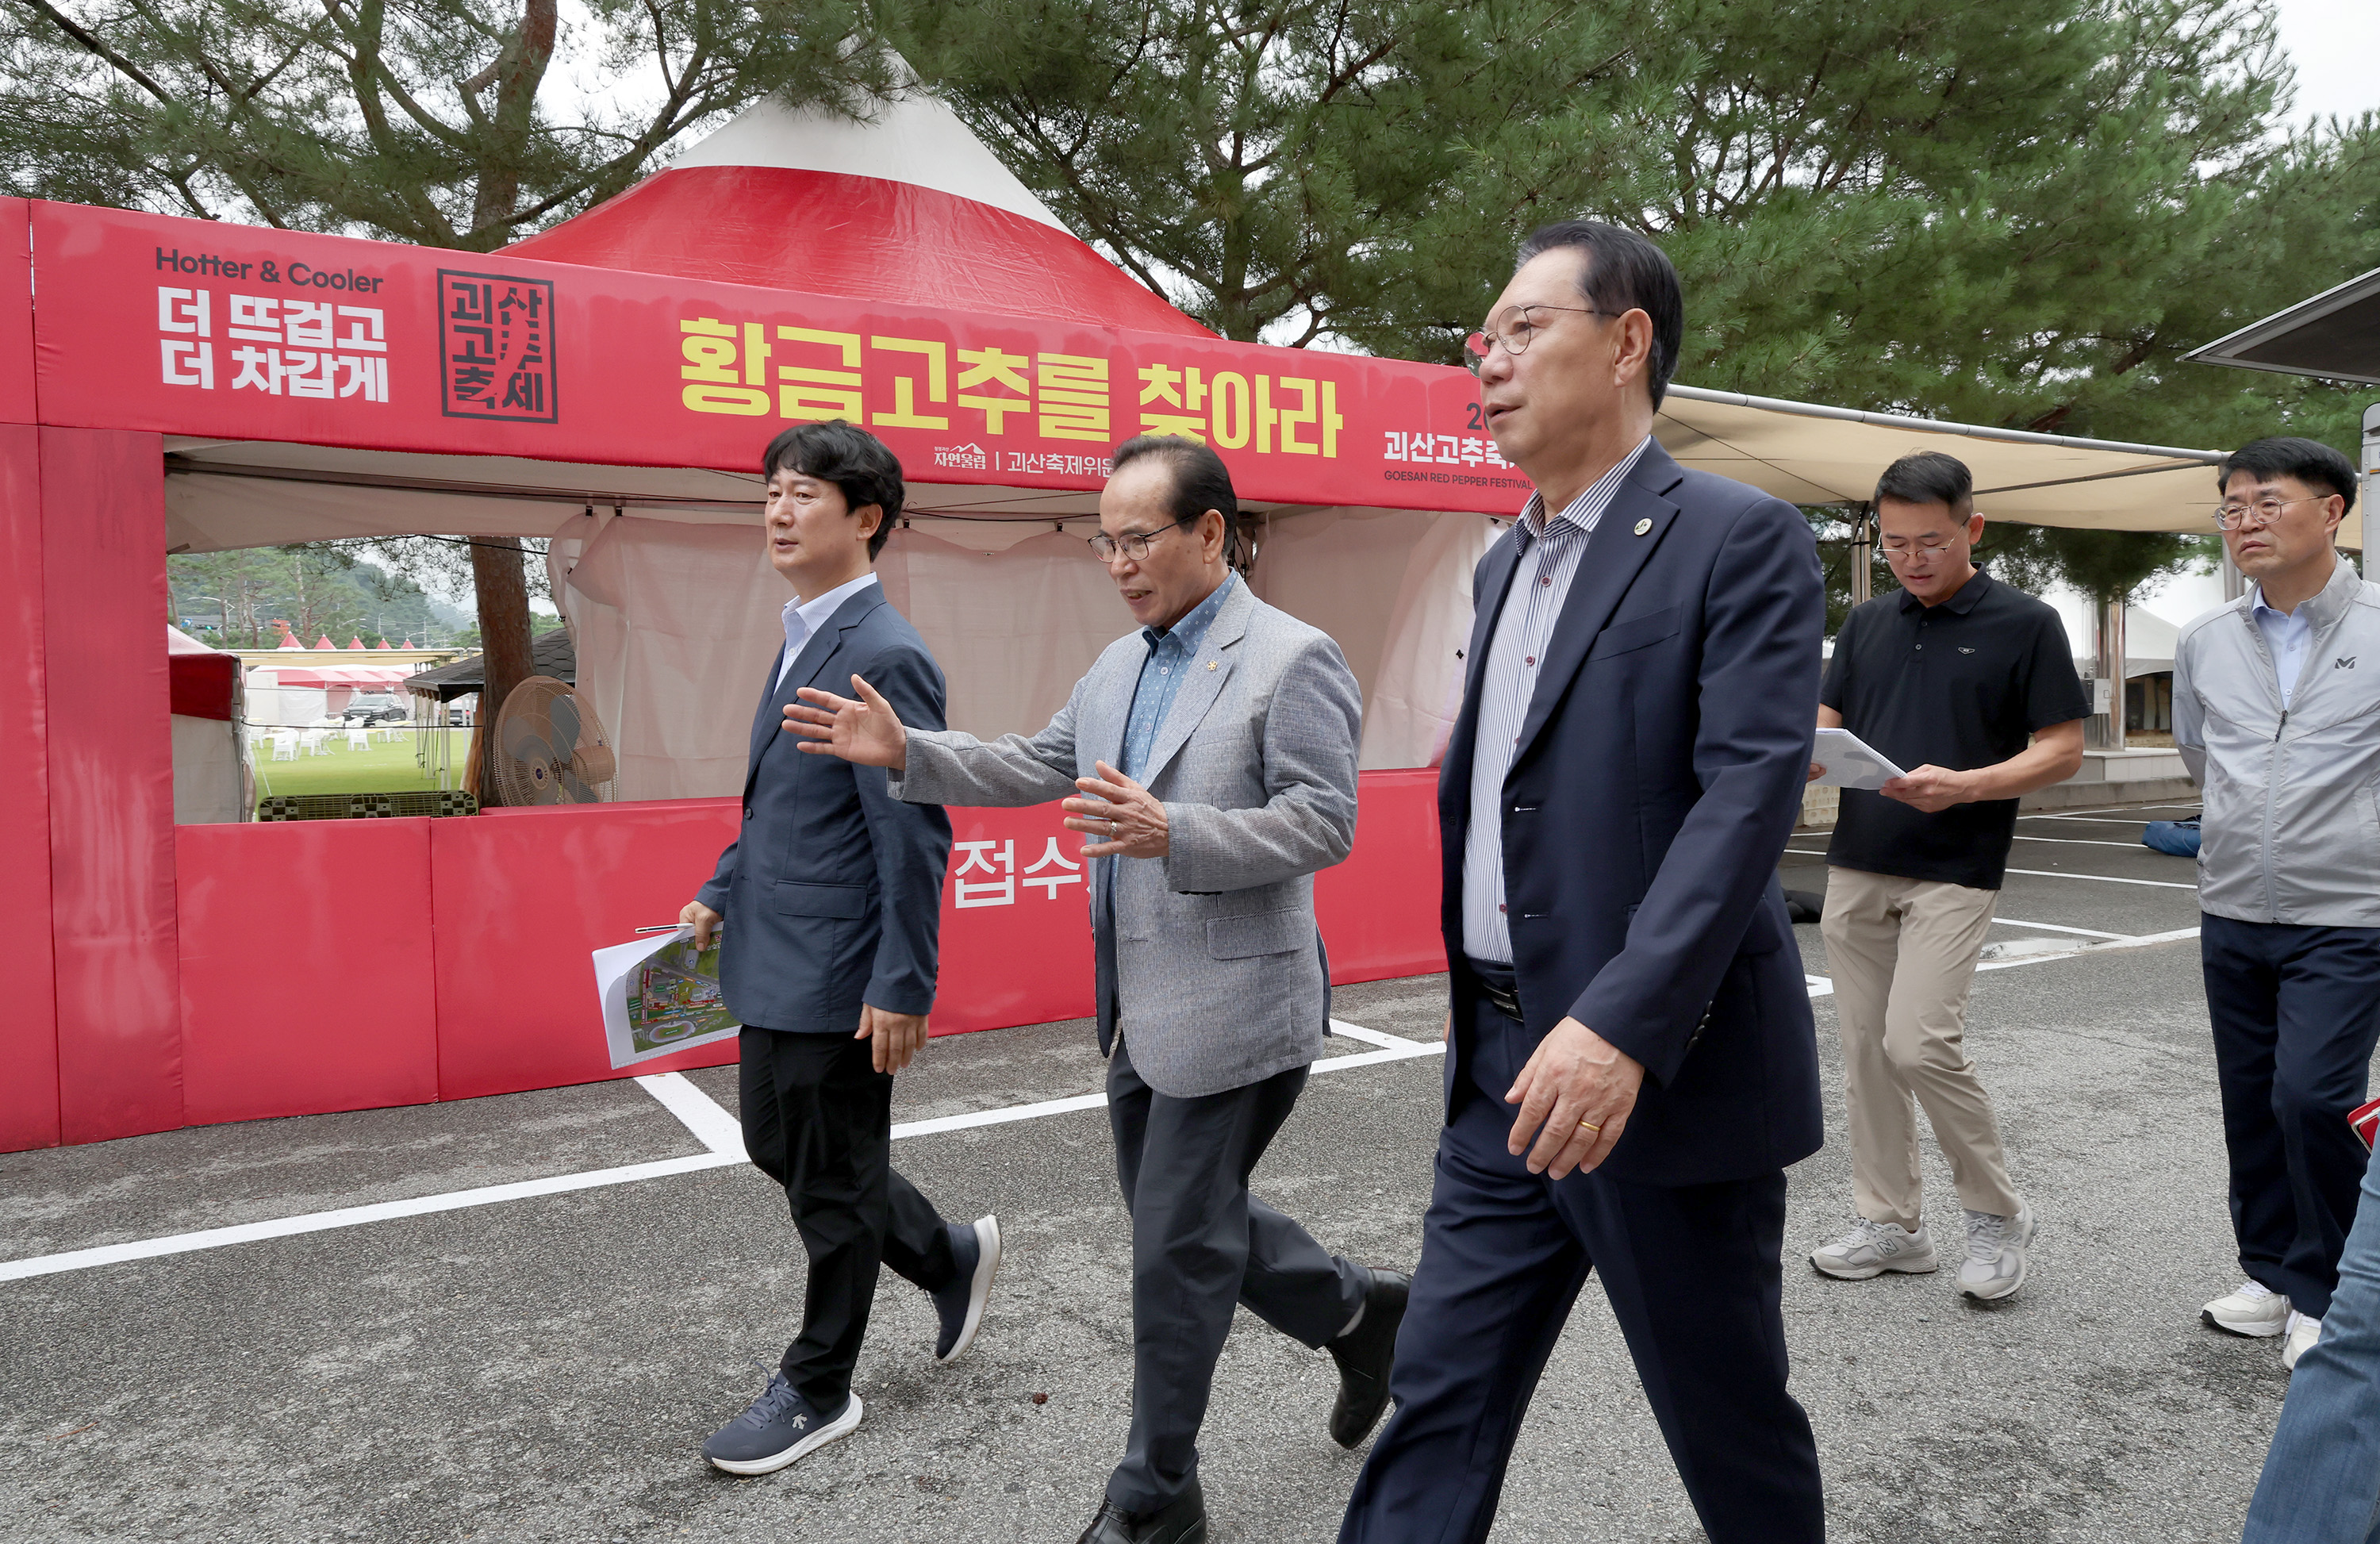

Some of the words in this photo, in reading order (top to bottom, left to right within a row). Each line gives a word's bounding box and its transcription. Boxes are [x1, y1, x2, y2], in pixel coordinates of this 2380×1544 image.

[156, 247, 252, 280] Hotter
[259, 260, 282, 284] &
[287, 262, 384, 294] Cooler
[158, 286, 211, 337] 더
[228, 294, 387, 351] 뜨겁고
[451, 282, 543, 328] 괴산
[160, 339, 214, 390] 더
[231, 344, 390, 403] 차갑게
[454, 366, 544, 412] 축제
[680, 317, 1111, 443] 황금고추를
[1138, 363, 1344, 459] 찾아라
[1466, 402, 1490, 431] 2
[934, 451, 986, 470] 자연울림
[1384, 431, 1515, 470] 괴산고추축
[1384, 470, 1428, 482] GOESAN
[1430, 472, 1450, 483] RED
[1453, 474, 1488, 487] PEPPER
[1490, 478, 1533, 490] FESTIVAL
[954, 836, 1090, 908] 접수
